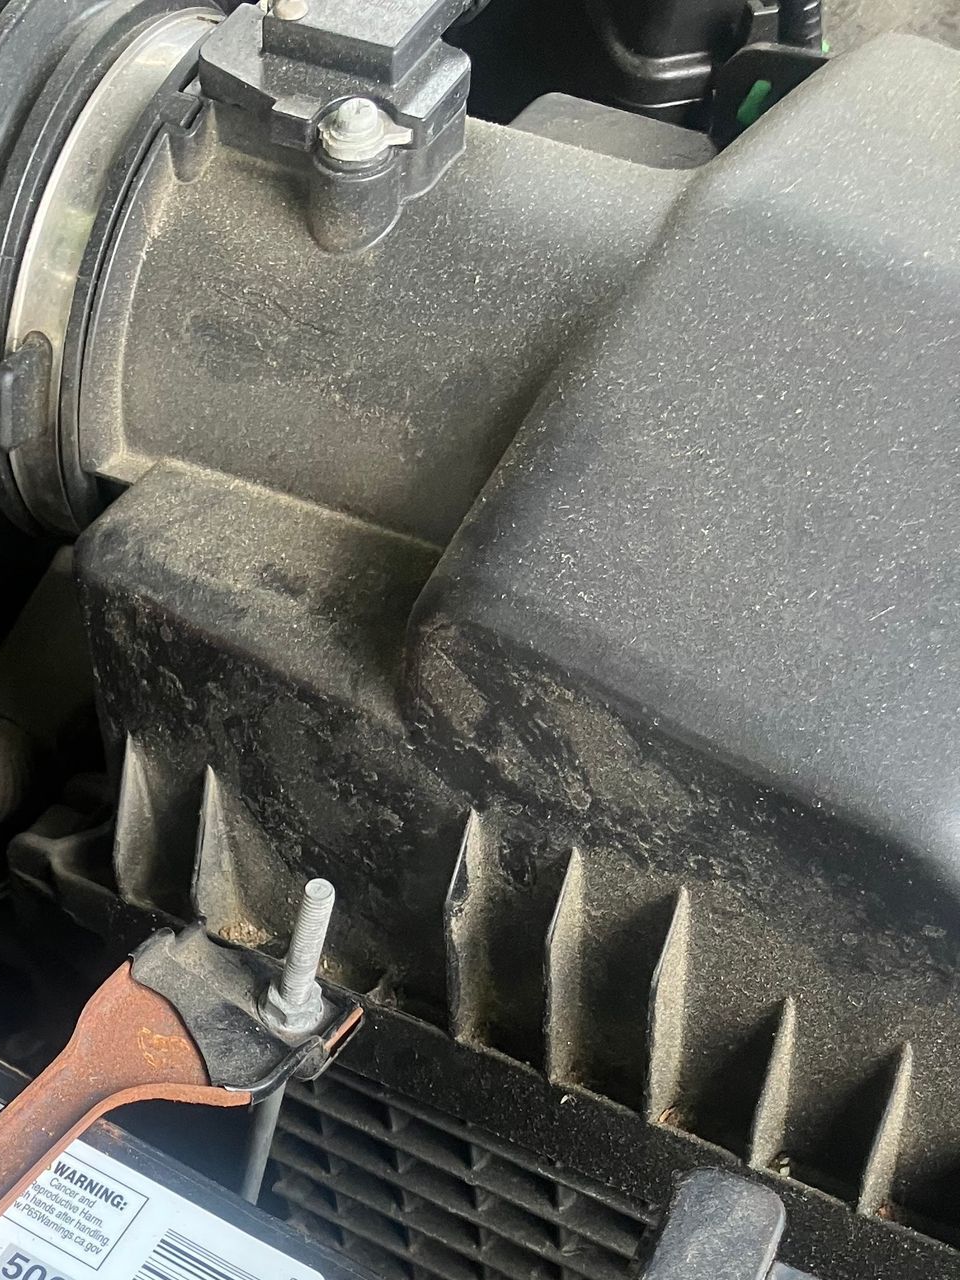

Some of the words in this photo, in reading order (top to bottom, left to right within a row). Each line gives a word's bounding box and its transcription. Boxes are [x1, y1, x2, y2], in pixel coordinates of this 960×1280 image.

[48, 1176, 80, 1199] Cancer
[76, 1193, 98, 1209] and
[52, 1159, 128, 1212] WARNING:
[28, 1192, 57, 1216] hands
[54, 1209, 76, 1226] after
[72, 1218, 111, 1248] handling.
[78, 1206, 104, 1229] Harm.
